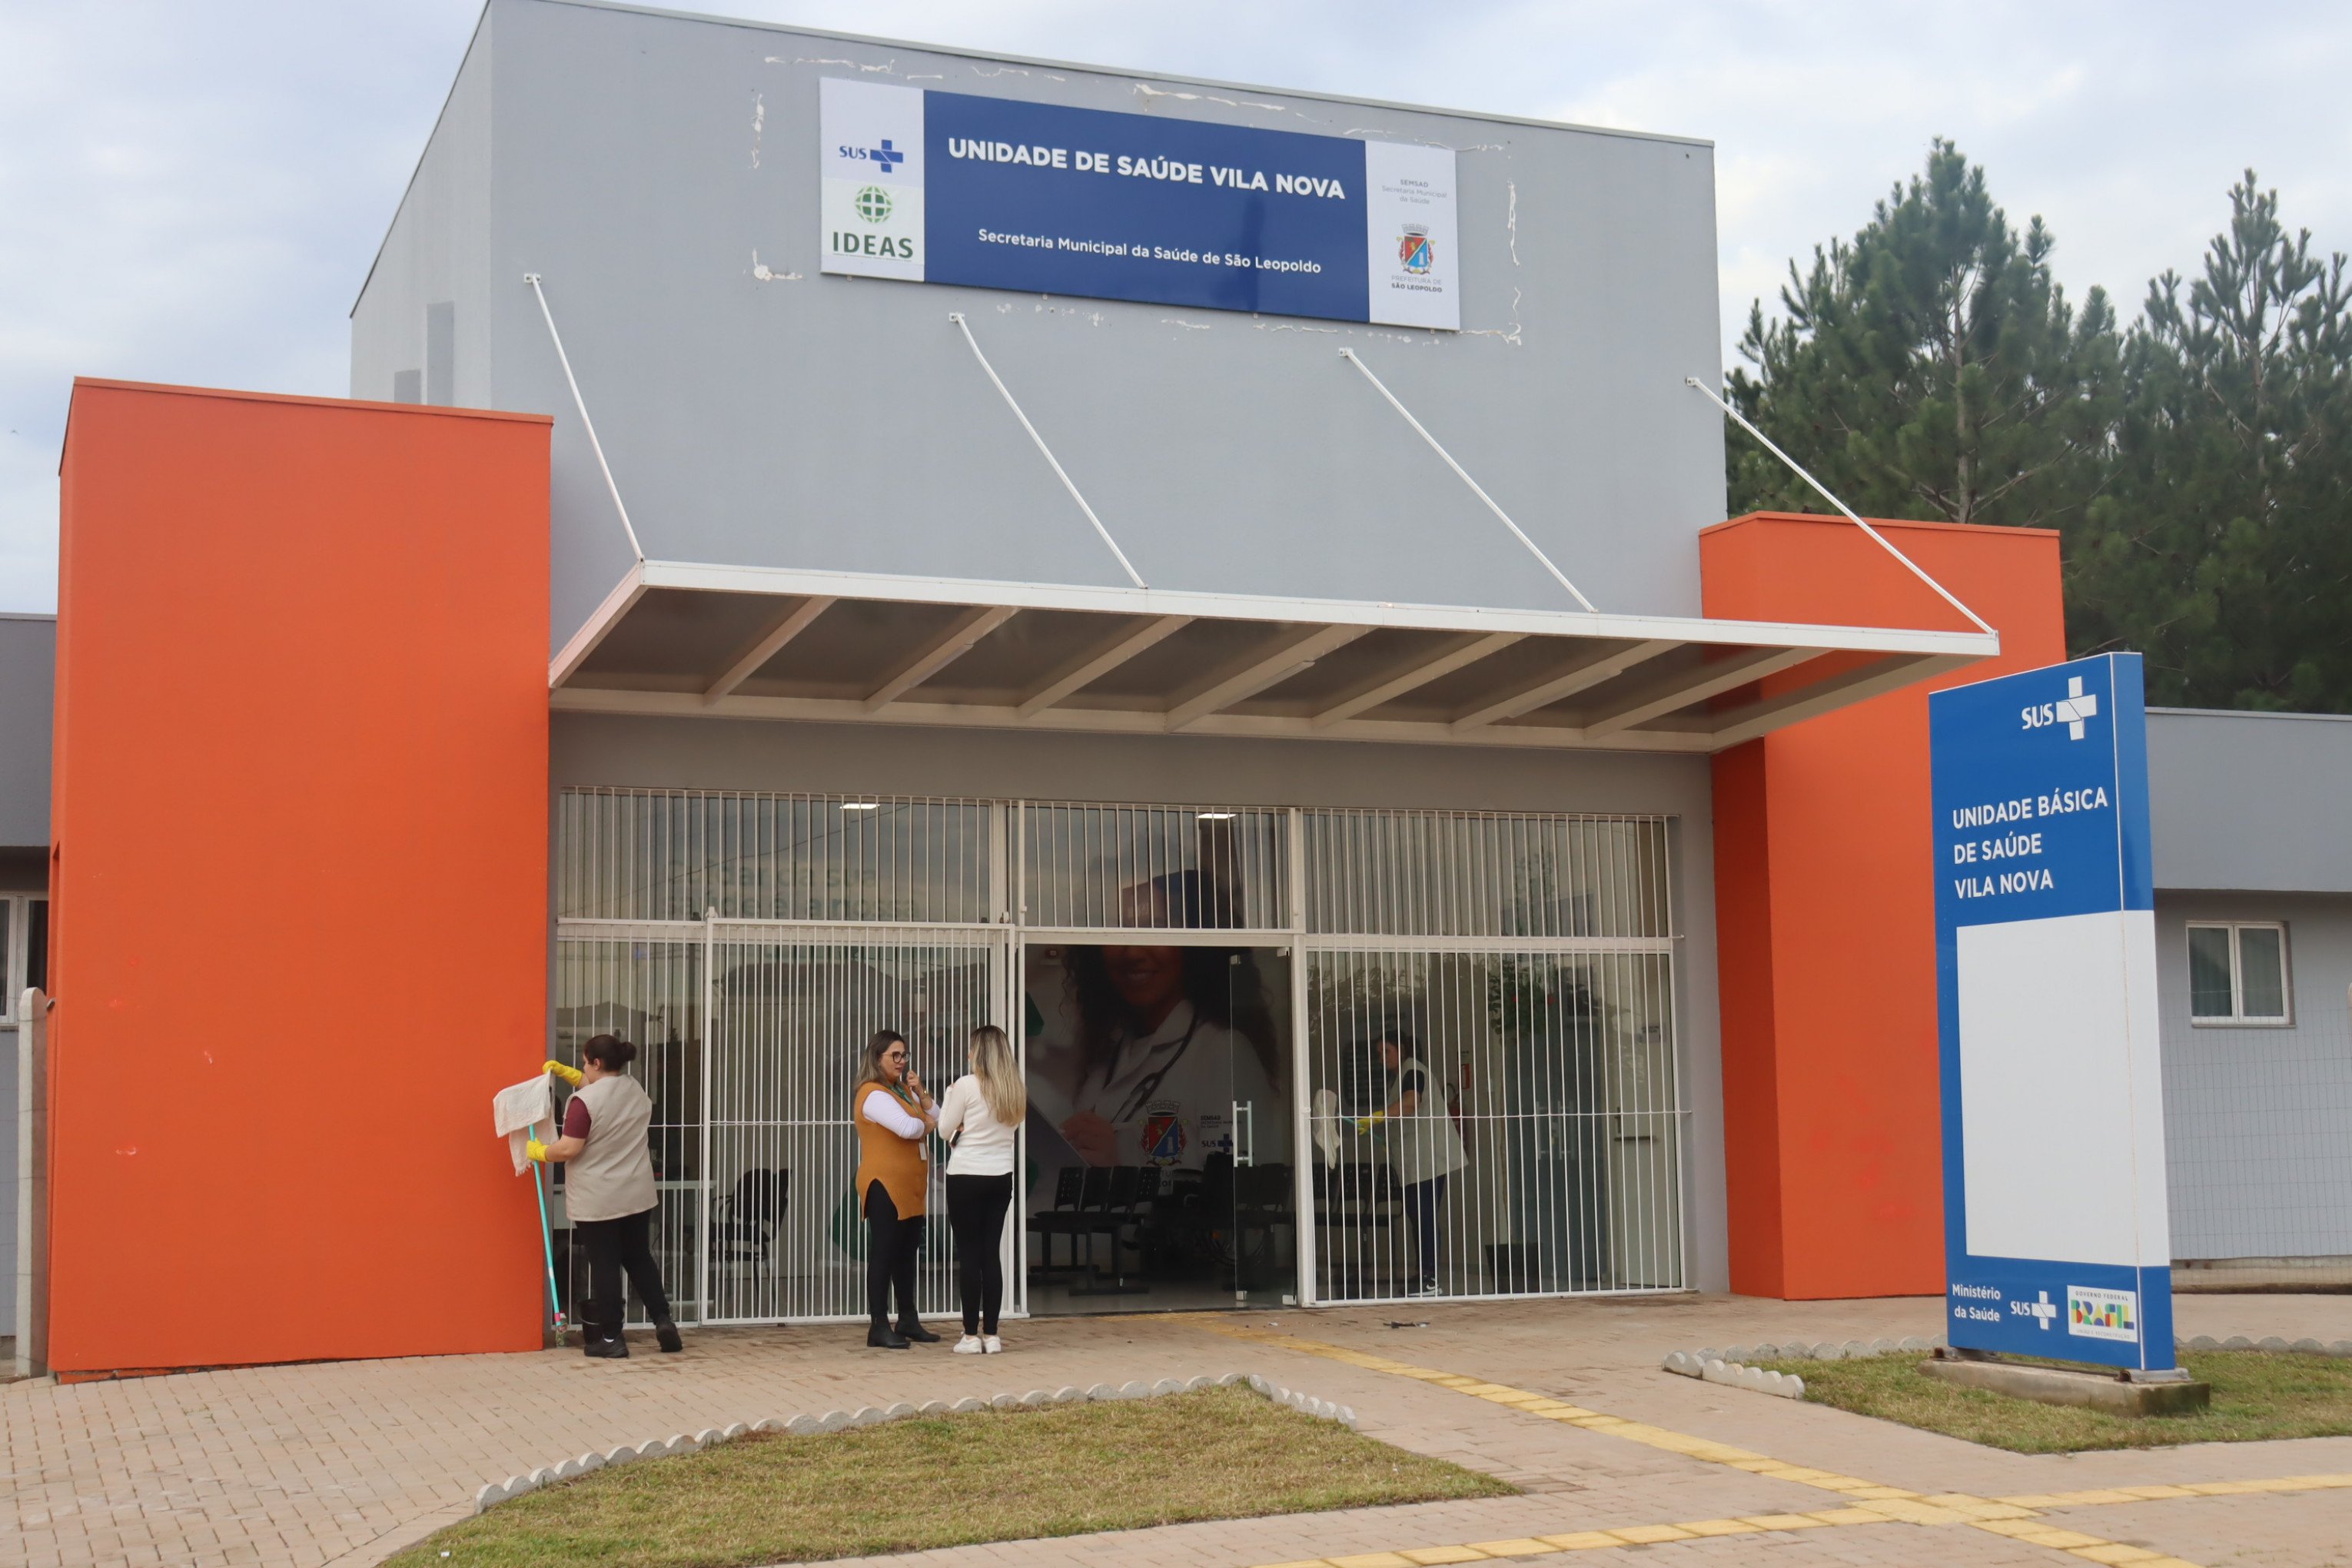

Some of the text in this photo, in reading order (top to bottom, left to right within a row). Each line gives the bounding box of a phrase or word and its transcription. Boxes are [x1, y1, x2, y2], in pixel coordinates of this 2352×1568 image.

[839, 145, 867, 160] SUS
[948, 137, 1346, 200] UNIDADE DE SAÚDE VILA NOVA
[1381, 185, 1447, 198] Secretaria Municipal
[832, 231, 913, 259] IDEAS
[978, 228, 1321, 274] Secretaria Municipal da Saúde de São Leopoldo
[1391, 275, 1431, 285] PREFEITURA
[1407, 284, 1443, 293] LEOPOLDO
[2021, 703, 2054, 729] SUS
[1953, 787, 2108, 829] UNIDADE BÁSICA
[1954, 831, 2042, 865] DE SAÚDE
[1955, 869, 2054, 899] VILA NOVA
[1952, 1283, 2001, 1301] Ministério
[2075, 1290, 2128, 1302] GOVERNO FEDERAL
[1954, 1305, 2001, 1322] da Saúde
[2010, 1301, 2031, 1316] SUS
[2070, 1299, 2135, 1330] BRASIL
